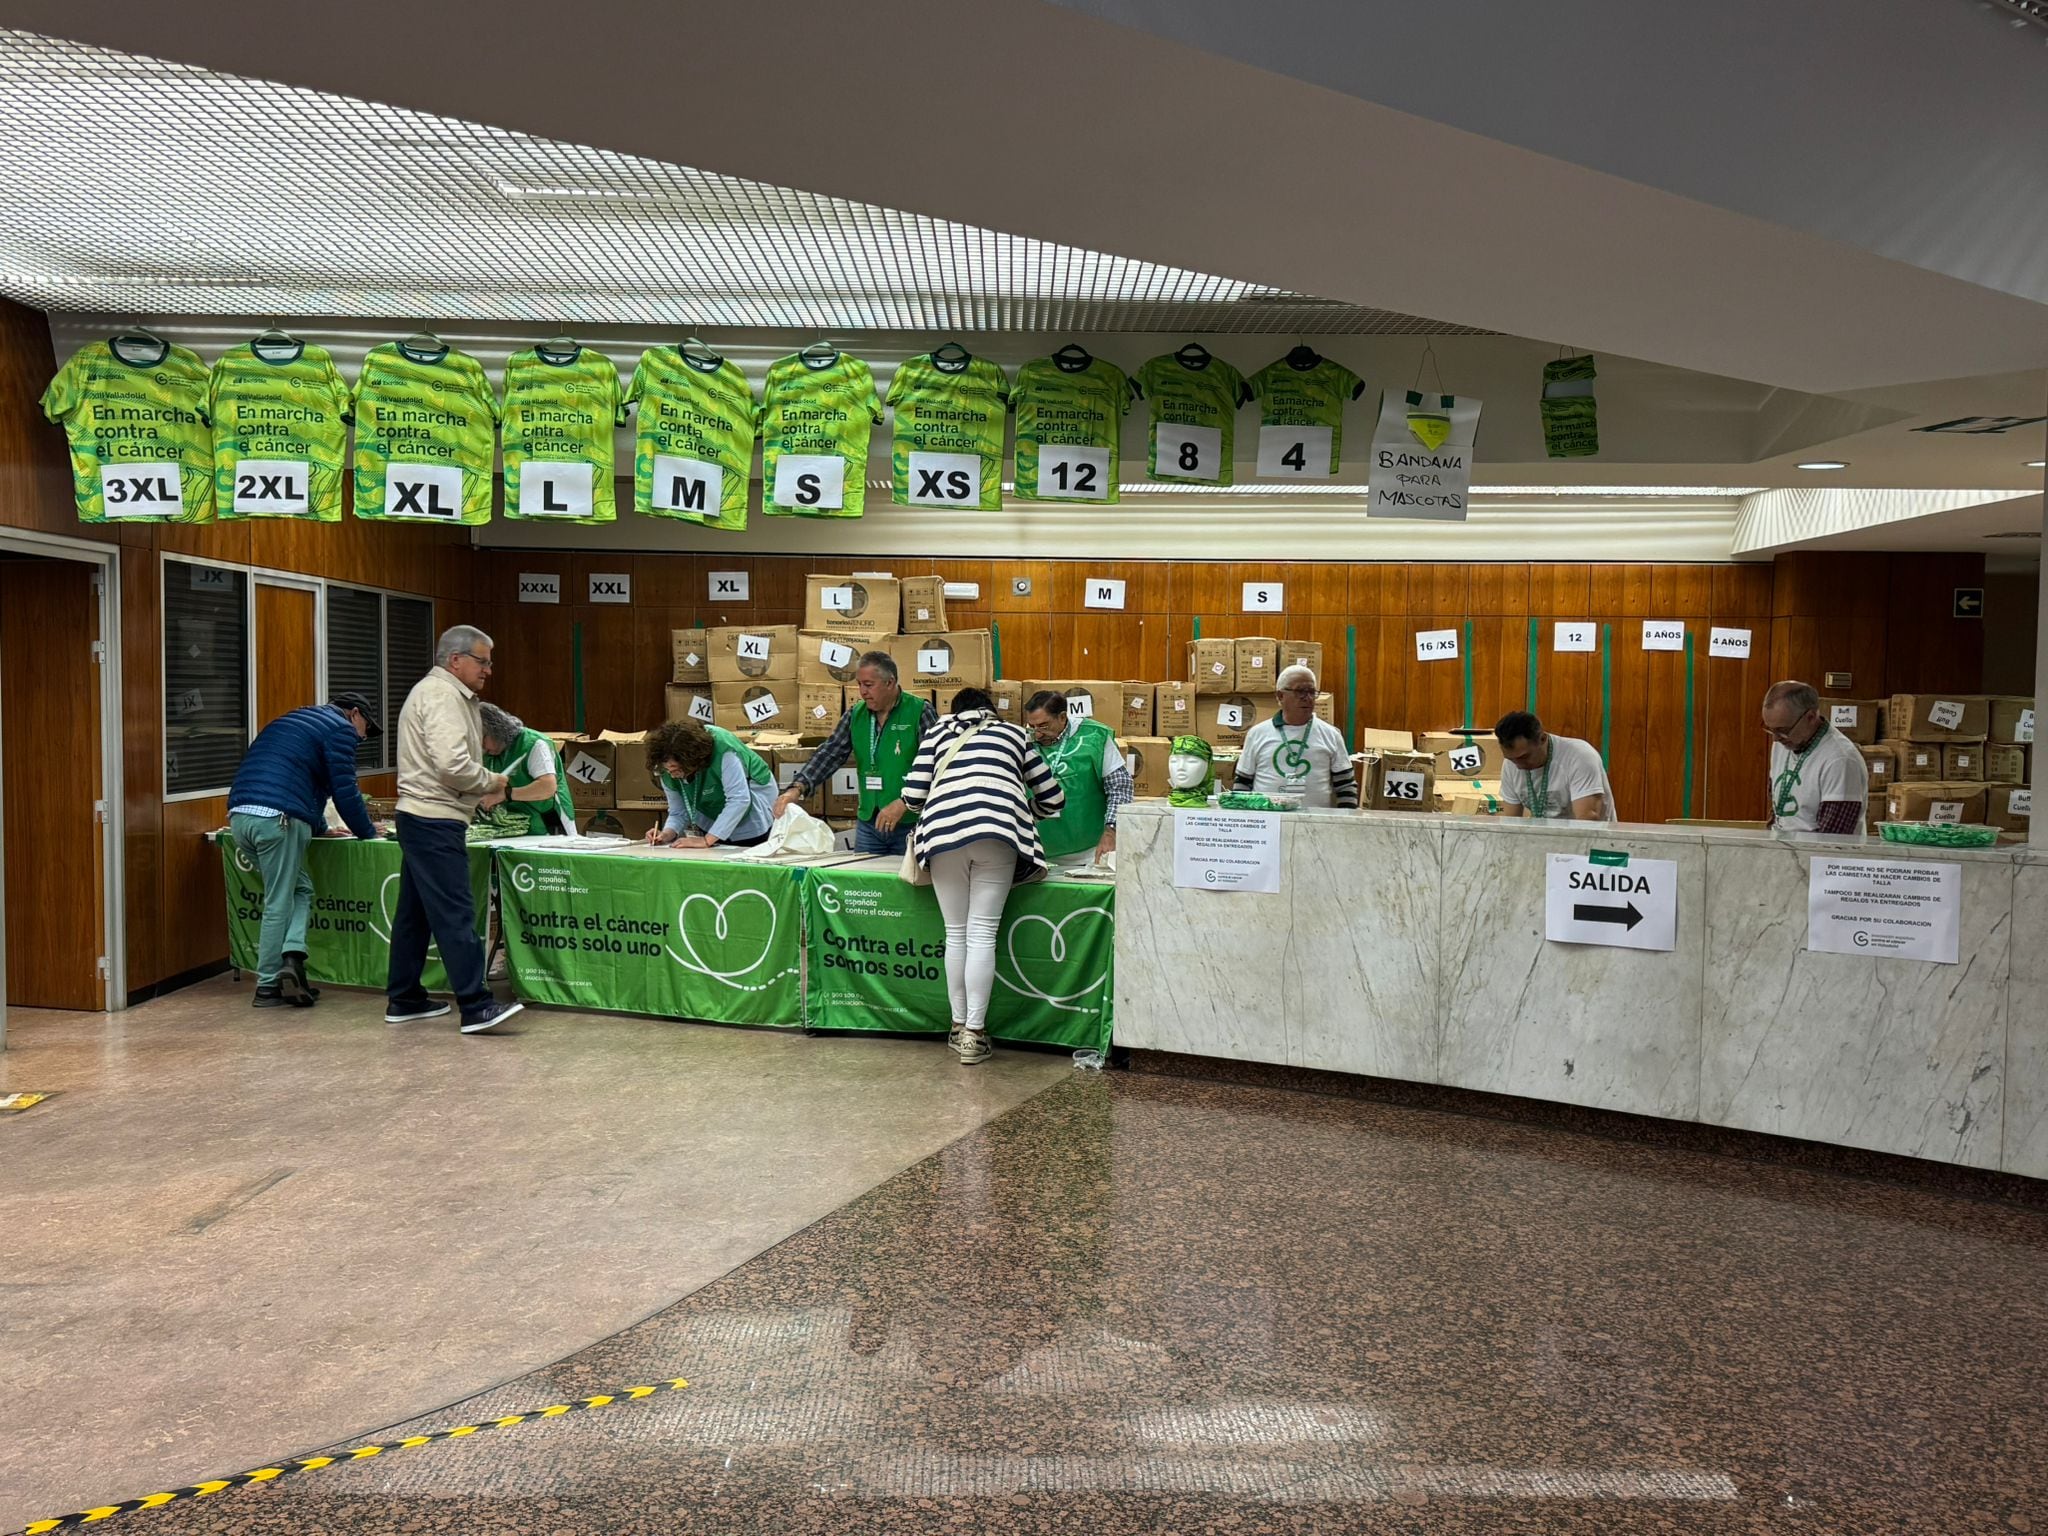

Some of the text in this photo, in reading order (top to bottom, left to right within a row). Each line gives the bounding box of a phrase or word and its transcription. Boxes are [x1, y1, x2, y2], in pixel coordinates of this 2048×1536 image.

[1163, 400, 1218, 415] En marcha
[1286, 396, 1325, 407] marcha
[93, 405, 196, 424] En marcha
[237, 405, 324, 423] En marcha
[376, 407, 466, 427] En marcha
[540, 410, 593, 424] marcha
[661, 403, 678, 417] En
[782, 409, 847, 421] En marcha
[915, 407, 987, 422] En marcha
[1036, 408, 1104, 421] En marcha
[1163, 412, 1196, 423] contra
[94, 424, 158, 439] contra
[238, 422, 289, 436] contra
[376, 425, 430, 440] contra
[914, 422, 958, 433] contra
[1036, 422, 1078, 432] contra
[240, 438, 311, 453] el cáncer
[535, 439, 584, 453] cáncer
[658, 434, 672, 446] el
[782, 436, 793, 449] el
[914, 434, 977, 448] el cáncer
[1036, 433, 1095, 446] el cáncer
[96, 442, 184, 459] el cáncer
[376, 440, 455, 458] el cáncer
[1178, 442, 1199, 471] 8
[1281, 442, 1306, 471] 4
[1379, 451, 1461, 469] BANDANA
[917, 469, 971, 499] XS
[1052, 462, 1097, 492] 12
[1396, 474, 1441, 486] PARA
[106, 478, 178, 503] 3XL
[237, 475, 304, 500] 2XL
[671, 477, 706, 510] M
[795, 473, 821, 504] S
[392, 481, 454, 516] XL
[543, 480, 568, 512] L
[1379, 490, 1461, 509] MASCOTAS
[520, 583, 557, 594] XXXL
[592, 582, 627, 595] XXL
[718, 580, 740, 593] XL
[1098, 587, 1112, 600] M
[833, 593, 841, 605] L
[1257, 591, 1268, 603] S
[1568, 633, 1582, 642] 12
[1654, 630, 1681, 639] AÑOS
[744, 641, 761, 655] XL
[1420, 642, 1433, 651] 16
[1721, 637, 1748, 647] AÑOS
[830, 649, 837, 662] L
[929, 656, 937, 668] L
[696, 703, 712, 718] XL
[752, 703, 772, 718] XL
[1069, 702, 1084, 715] M
[1228, 710, 1237, 722] S
[1452, 754, 1477, 770] XS
[576, 761, 596, 782] XL
[847, 776, 855, 790] L
[1387, 780, 1419, 799] XS
[1838, 871, 1871, 879] CAMISETAS
[1569, 871, 1651, 894] SALIDA
[844, 889, 882, 898] asociación
[1824, 889, 1853, 897] TAMPOCO
[1903, 894, 1931, 902] CAMBIOS
[316, 895, 373, 914] cáncer
[845, 899, 878, 907] española
[1840, 896, 1869, 904] REGALOS
[1880, 899, 1921, 907] ENTREGADOS
[845, 907, 903, 918] contra el cáncer
[1832, 914, 1858, 922] GRACIAS
[309, 913, 366, 933] olo uno
[520, 908, 669, 936] Contra el cáncer
[521, 931, 662, 957] somos solo uno
[823, 928, 890, 955] Contra
[895, 938, 916, 957] el
[824, 953, 939, 980] somos solo
